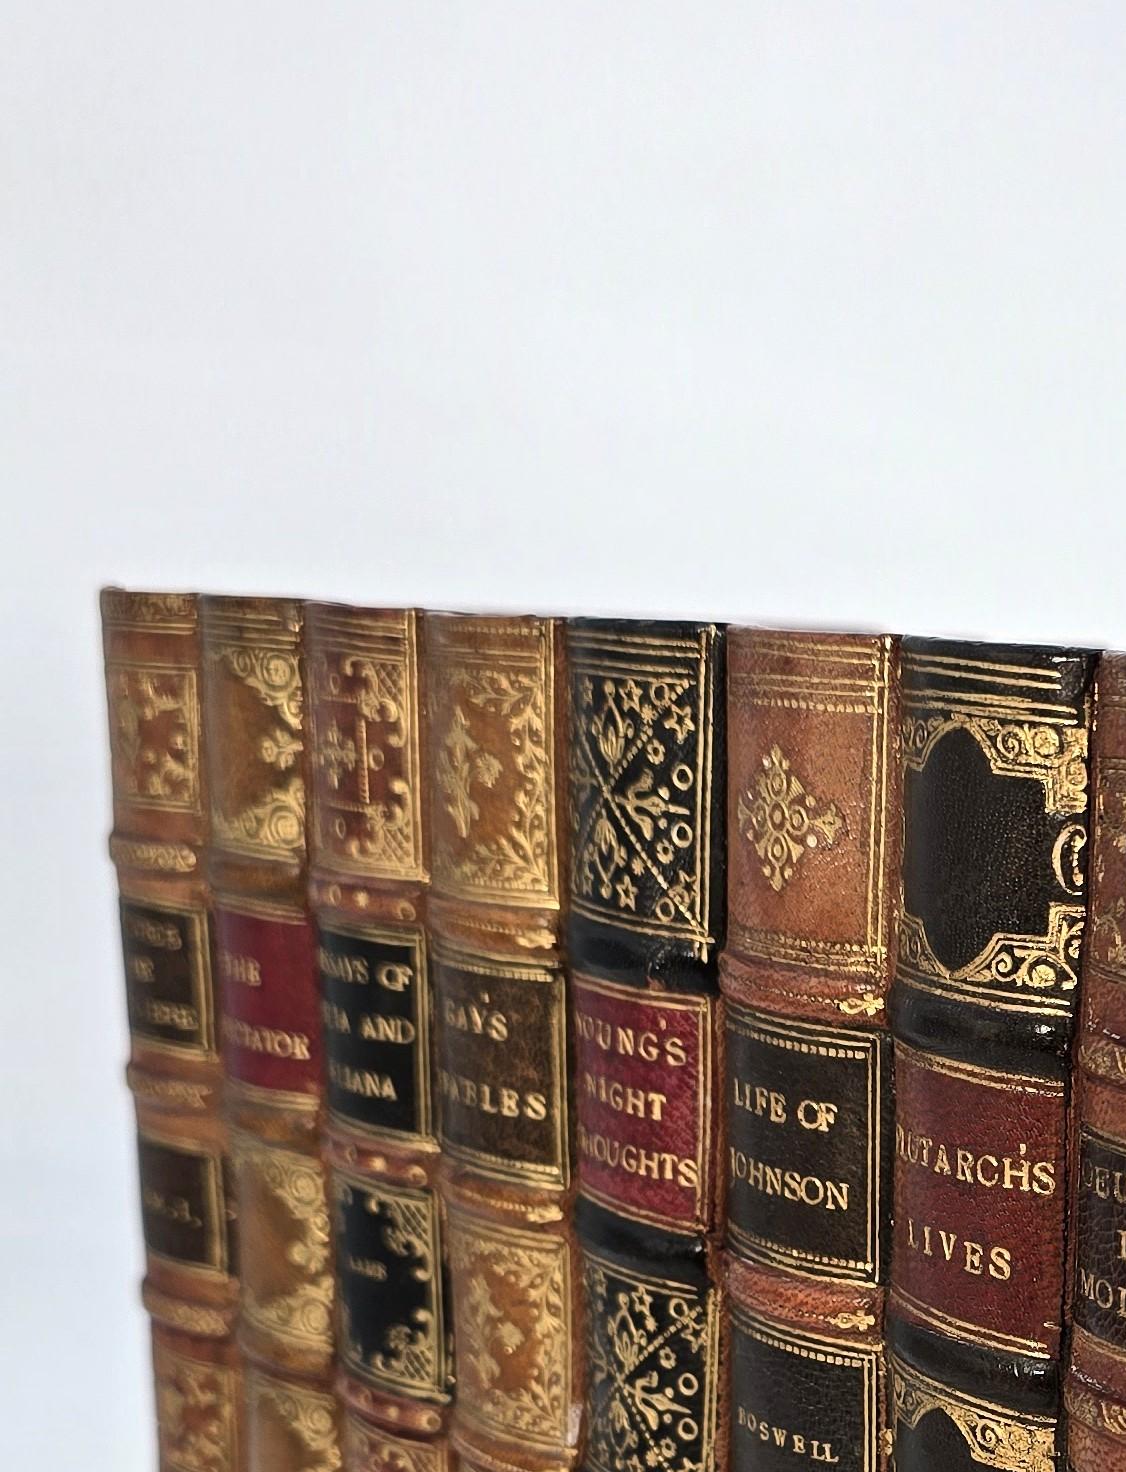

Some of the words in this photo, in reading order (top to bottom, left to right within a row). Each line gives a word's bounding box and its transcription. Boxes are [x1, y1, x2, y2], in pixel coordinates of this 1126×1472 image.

[376, 961, 414, 992] OF
[360, 1013, 415, 1044] AND
[584, 1071, 667, 1121] NIGHT
[733, 1077, 787, 1124] LIFE
[797, 1099, 838, 1132] OF
[729, 1146, 849, 1211] JOHNSON
[908, 1217, 1011, 1280] LIVES
[738, 1405, 840, 1463] BOSWELL
